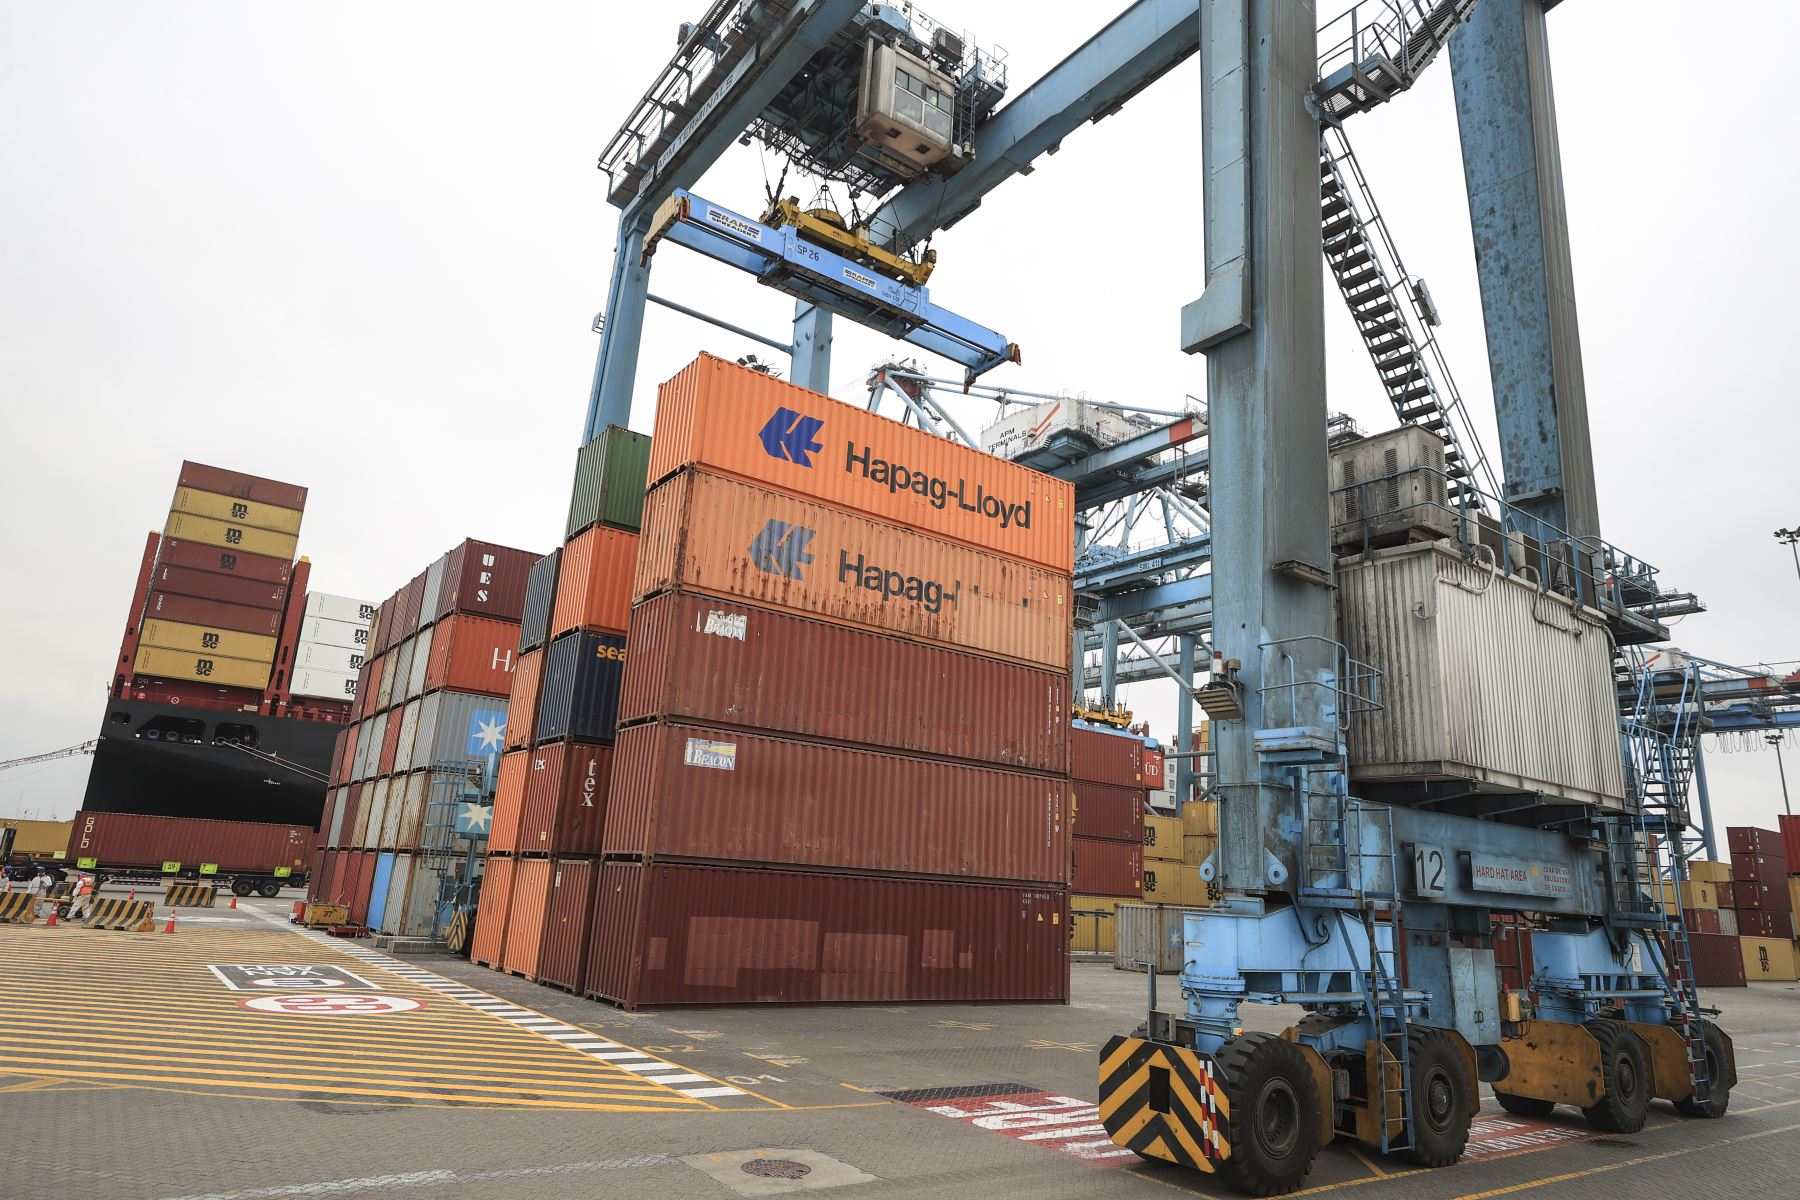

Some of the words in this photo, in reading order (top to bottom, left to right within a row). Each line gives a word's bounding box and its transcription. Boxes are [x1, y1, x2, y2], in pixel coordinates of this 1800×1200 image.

[678, 75, 734, 143] TERMINALS
[711, 216, 757, 239] SPREADERS
[720, 214, 748, 230] RAM
[797, 244, 808, 256] SP
[808, 249, 820, 262] 26
[988, 430, 1027, 451] TERMINALS
[999, 428, 1015, 440] APM
[846, 440, 1031, 529] Hapag-Lloyd
[838, 549, 961, 614] Hapag-
[693, 749, 735, 769] BEACON
[580, 758, 597, 807] tex
[80, 817, 95, 849] GOLD
[1416, 850, 1444, 891] 12
[1476, 865, 1494, 879] HARD
[1495, 867, 1508, 880] HAT
[1510, 869, 1528, 882] AREA
[642, 1044, 707, 1053] 02
[724, 1073, 788, 1085] 01
